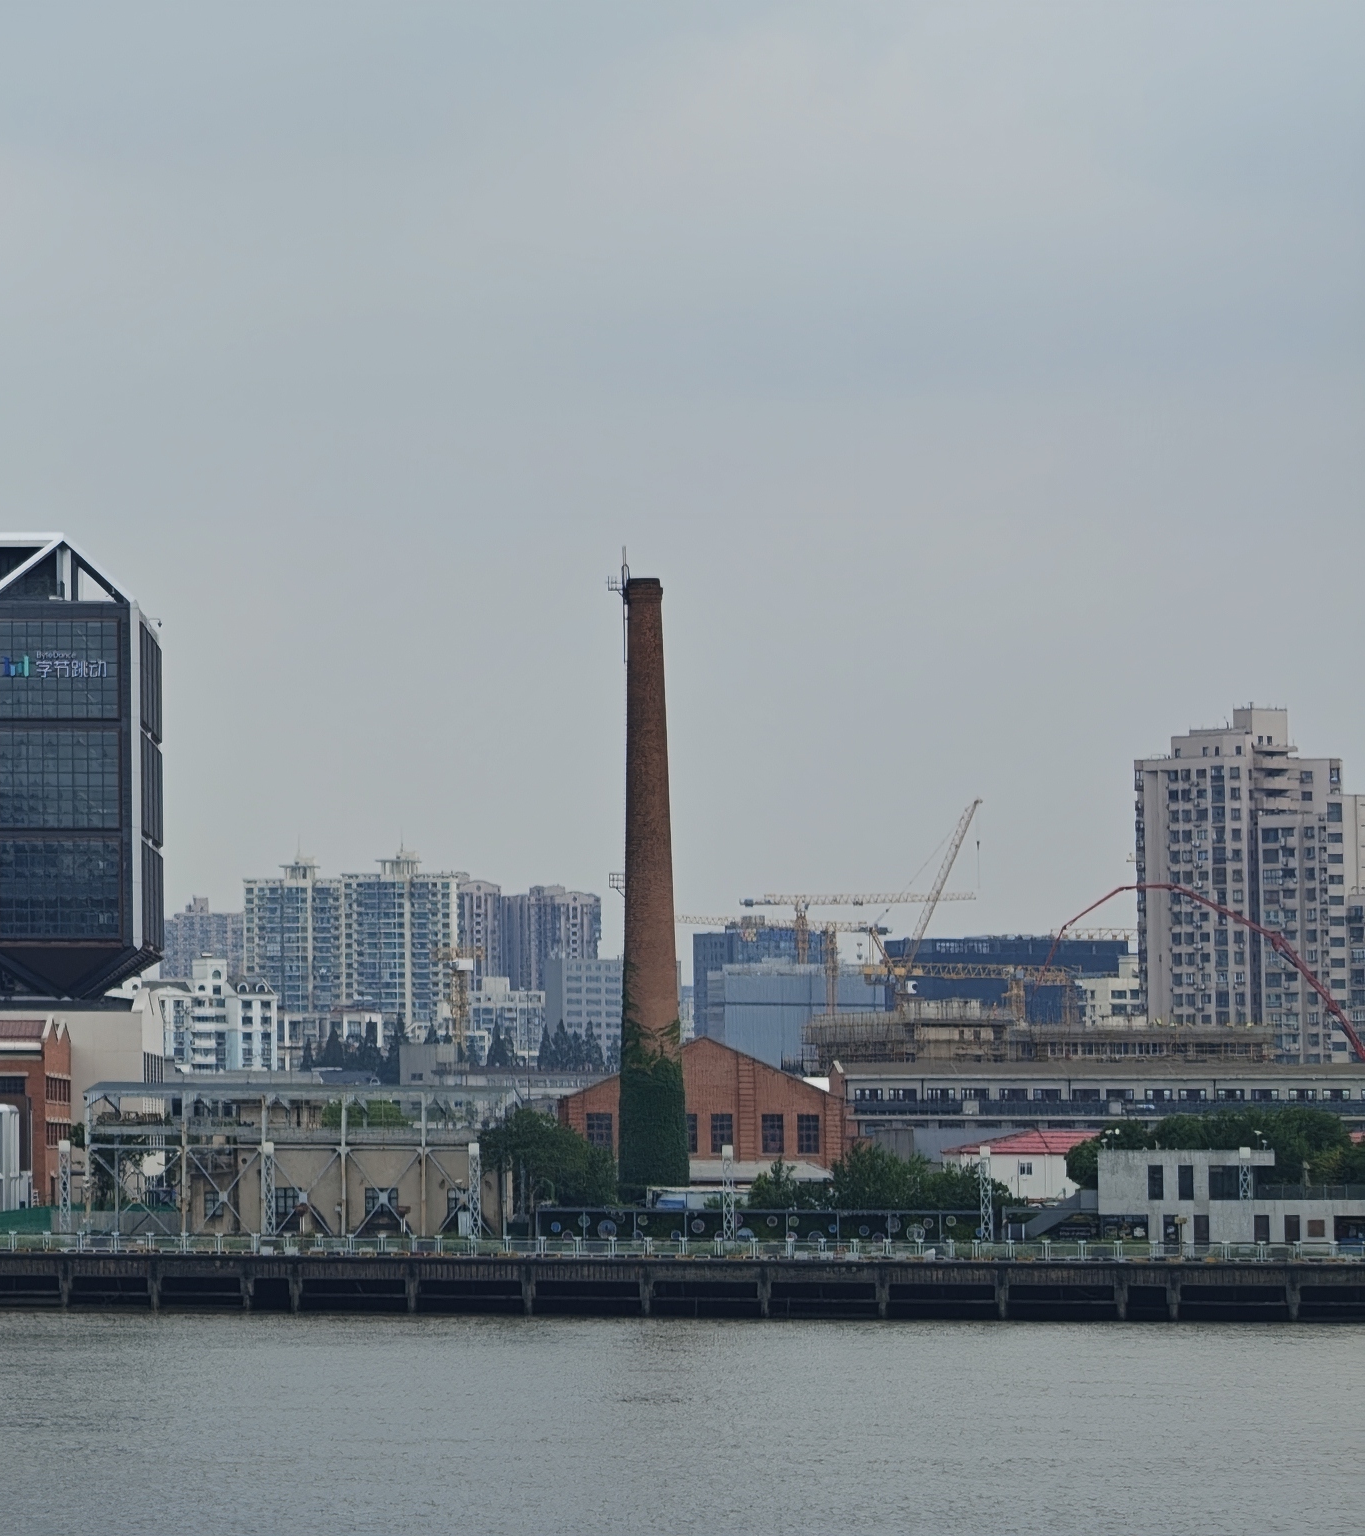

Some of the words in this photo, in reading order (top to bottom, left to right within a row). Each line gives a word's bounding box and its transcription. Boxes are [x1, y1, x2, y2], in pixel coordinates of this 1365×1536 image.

[36, 650, 77, 659] ByteDance
[36, 660, 107, 678] 字节跳动
